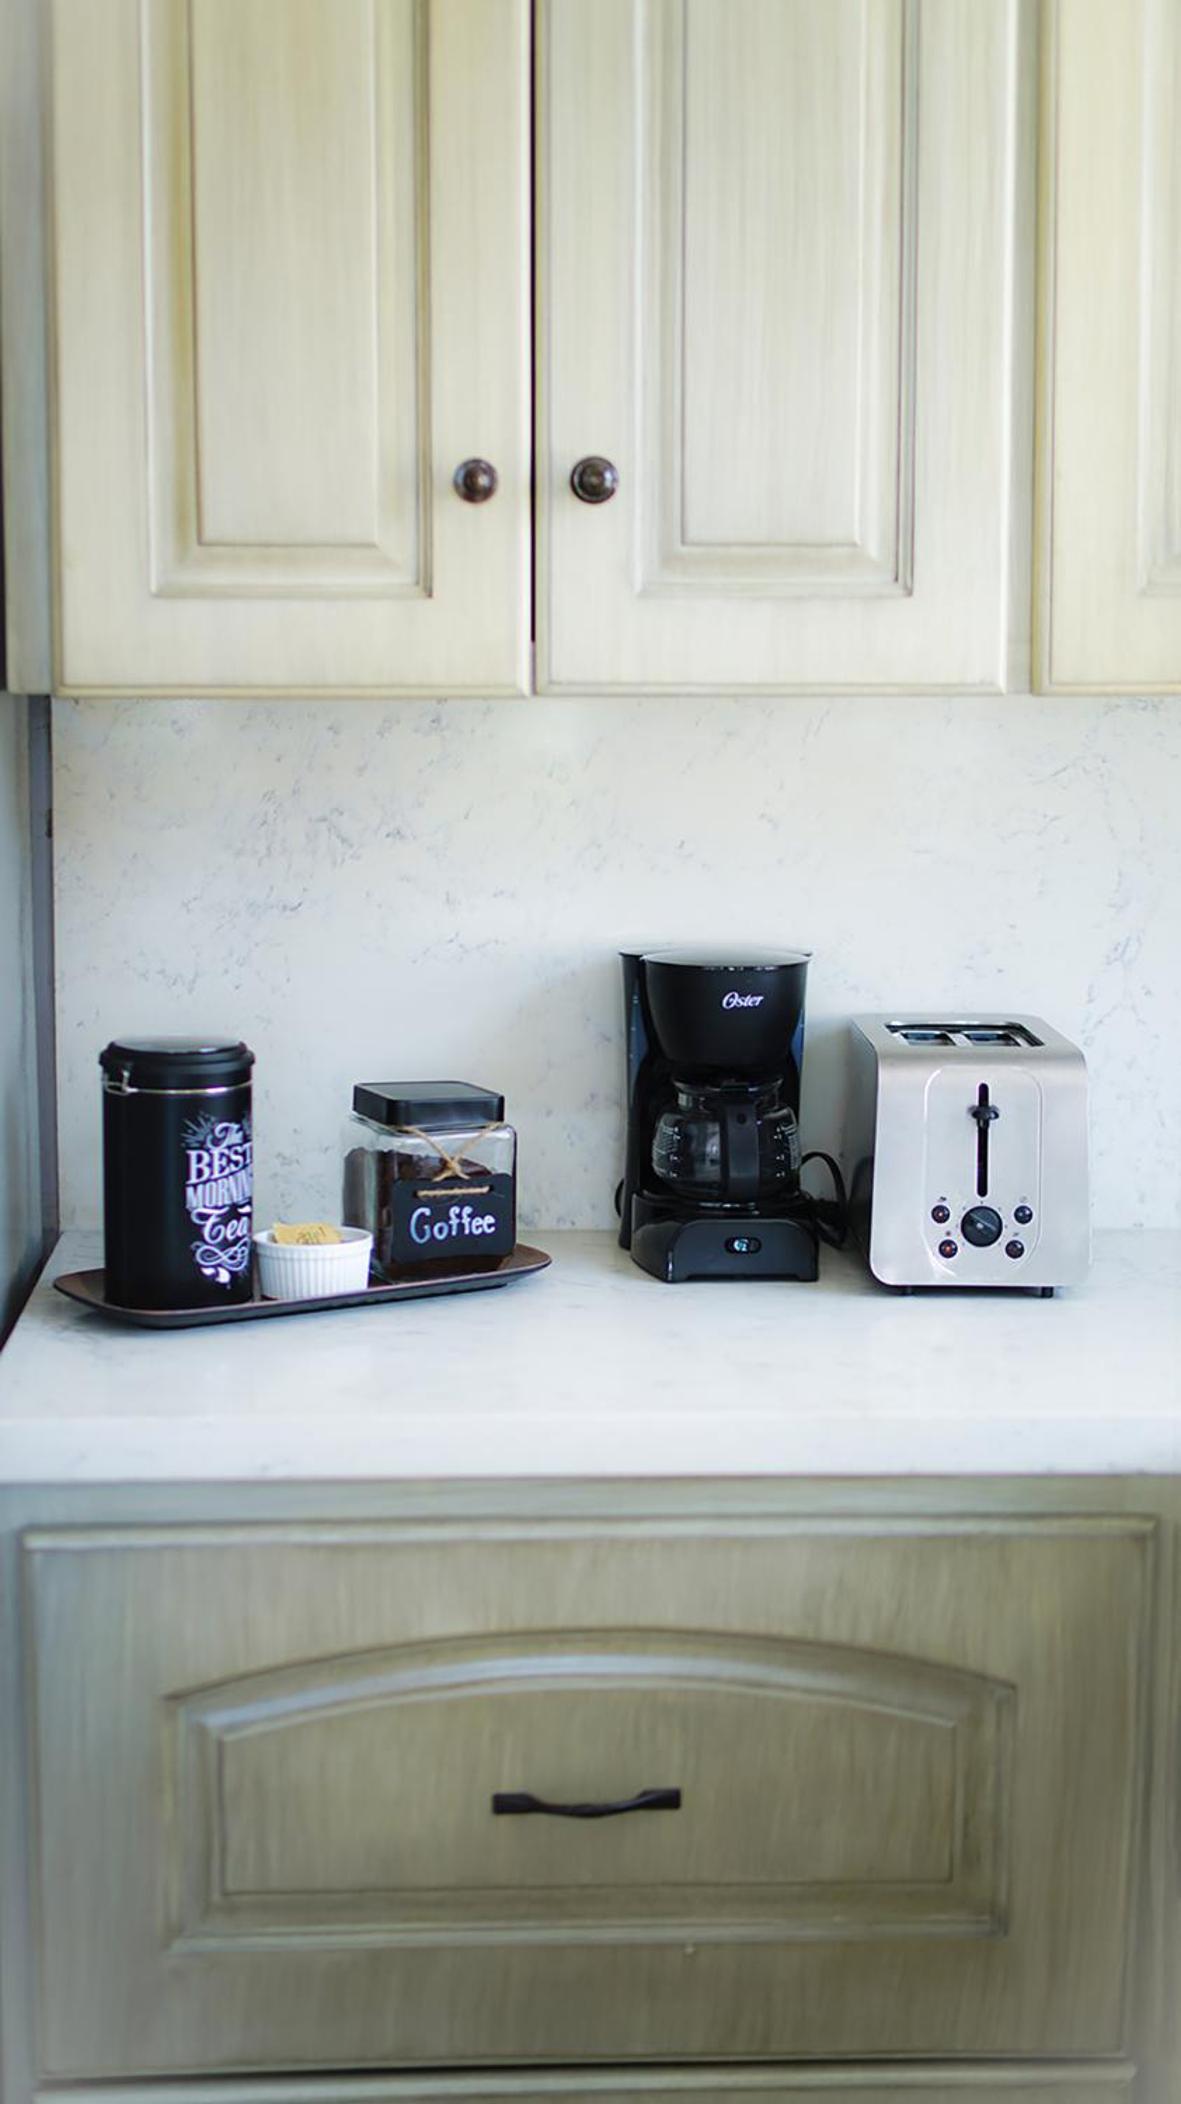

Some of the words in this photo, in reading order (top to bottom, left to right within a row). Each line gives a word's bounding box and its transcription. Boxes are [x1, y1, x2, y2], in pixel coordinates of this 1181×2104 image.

[722, 991, 764, 1010] Oster
[186, 1142, 252, 1184] BEST
[191, 1207, 249, 1244] Tea
[410, 1206, 496, 1244] Coffee
